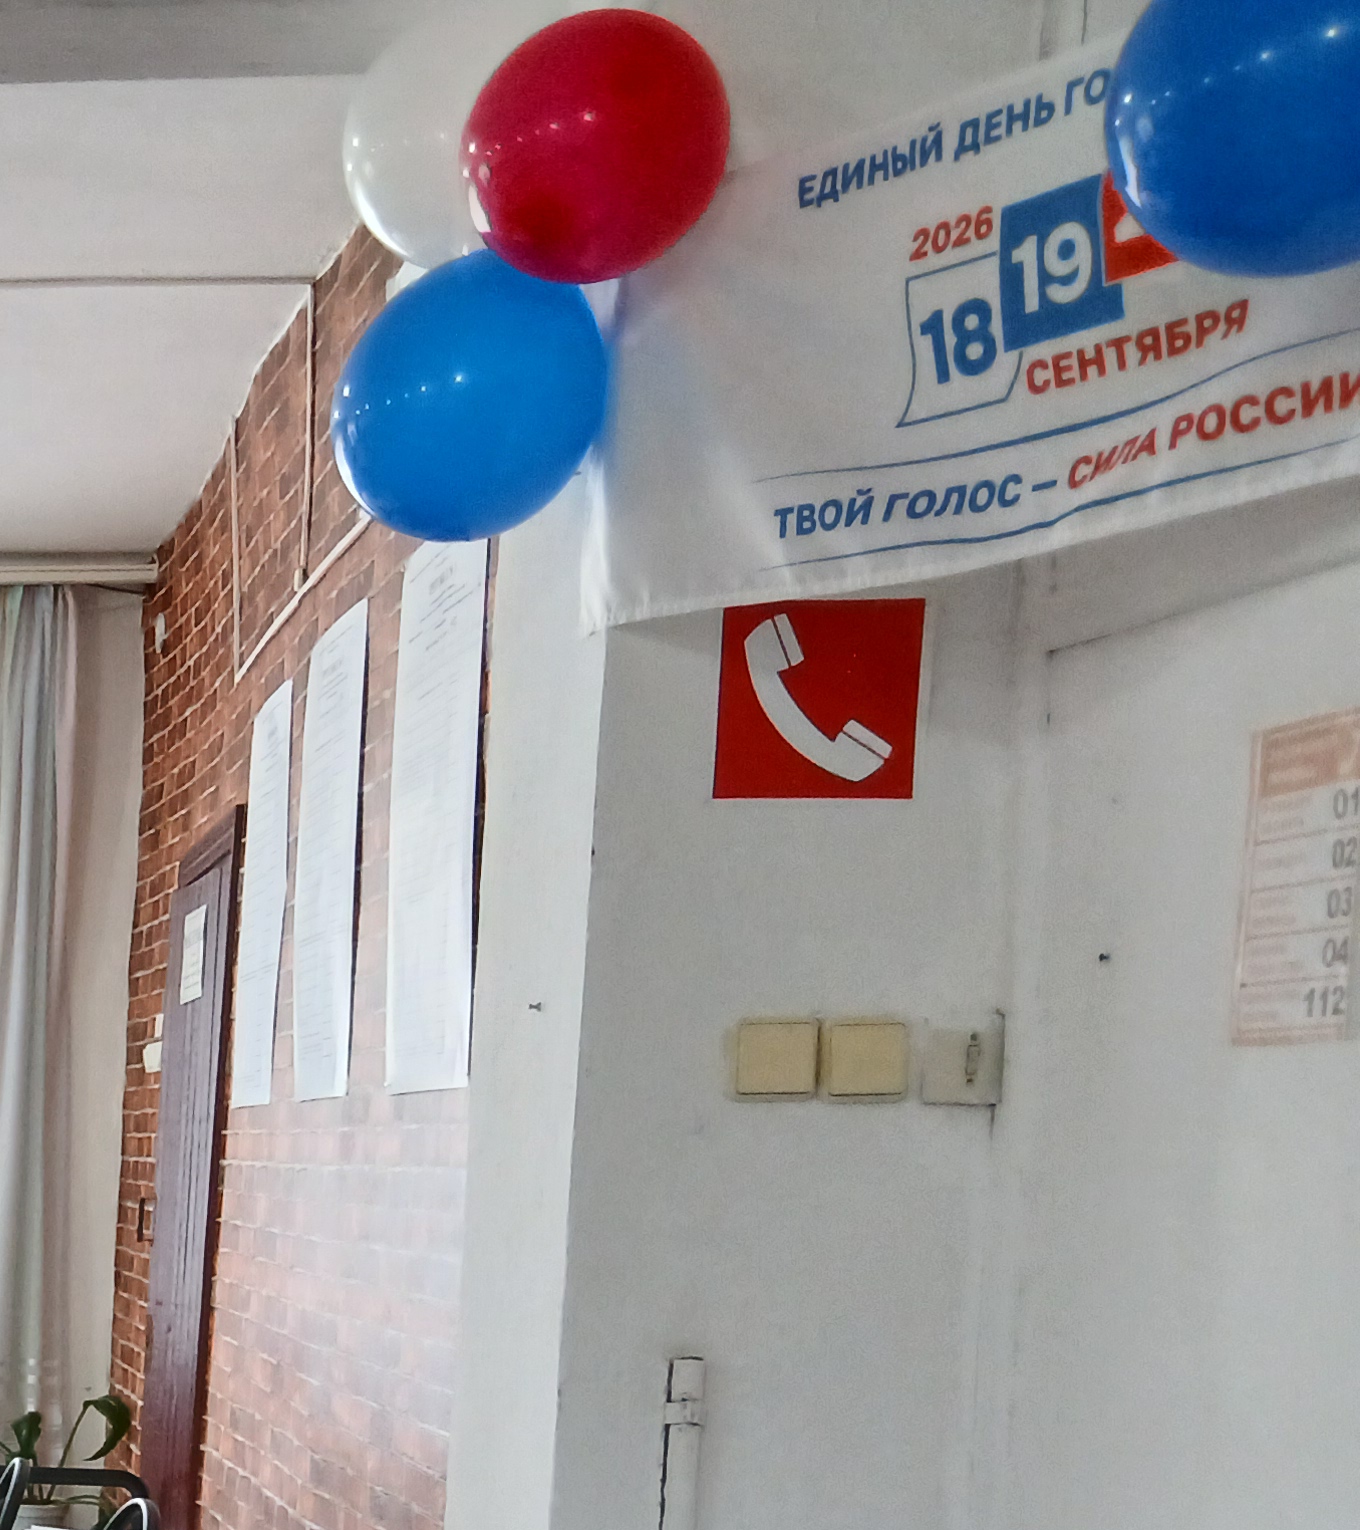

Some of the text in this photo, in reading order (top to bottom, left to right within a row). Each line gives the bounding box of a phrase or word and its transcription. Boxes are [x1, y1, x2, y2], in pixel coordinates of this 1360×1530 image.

[797, 121, 944, 208] ЕДИНЫЙ
[953, 92, 1055, 162] ДЕНЬ
[908, 206, 994, 262] 2026
[919, 221, 1093, 384] 18 19
[1025, 299, 1250, 395] СЕНТЯБРЯ
[773, 487, 876, 539] ТВОЙ
[882, 474, 1023, 522] ГОЛОС
[1067, 427, 1157, 490] СИЛА
[1332, 787, 1360, 820] 01
[1332, 836, 1358, 869] 02
[1327, 886, 1352, 919] 03
[1322, 936, 1349, 968] 04
[1303, 985, 1345, 1018] 112
